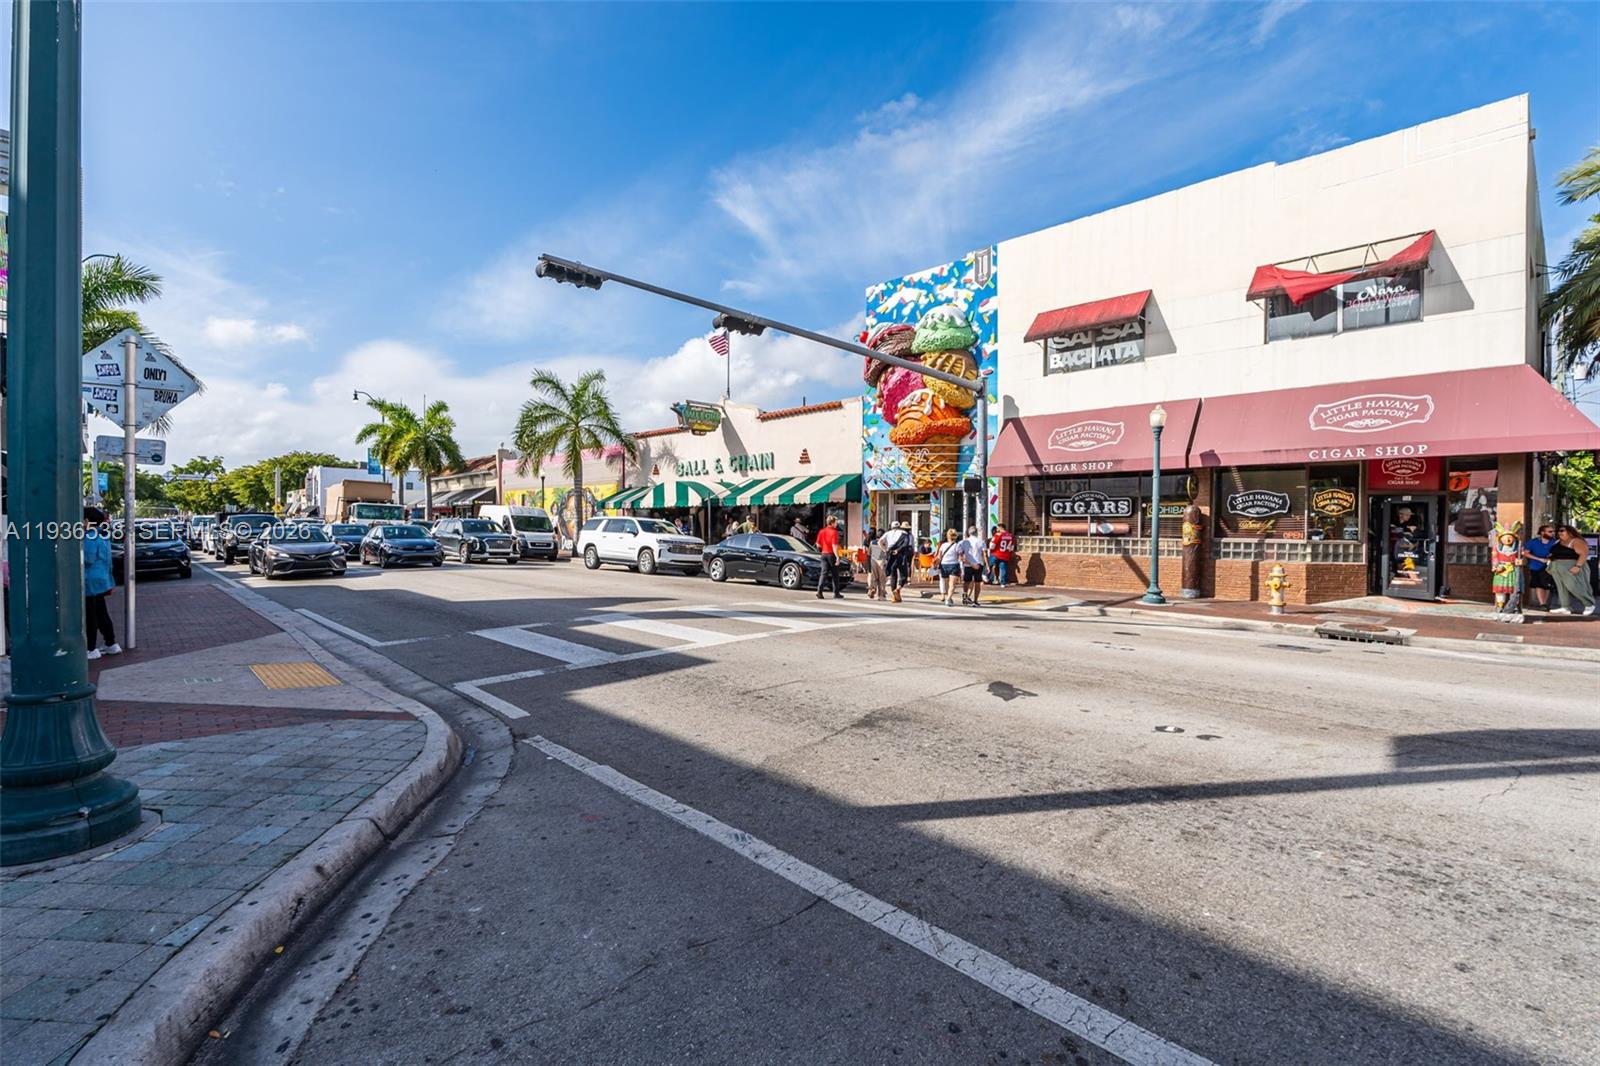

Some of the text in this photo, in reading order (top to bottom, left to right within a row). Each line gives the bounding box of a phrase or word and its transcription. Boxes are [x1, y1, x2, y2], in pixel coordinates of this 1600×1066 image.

[1054, 321, 1143, 349] SALSA
[1050, 342, 1140, 369] BACHATA
[1320, 400, 1420, 418] LITTLE HAVANA
[1326, 409, 1414, 424] CIGAR FACTORY
[1055, 425, 1116, 440] LITTLE HAVANA
[1058, 432, 1111, 444] CIGAR FACTORY
[1308, 444, 1428, 460] CIGAR SHOP
[675, 451, 775, 477] BALL & CHAIN
[1042, 462, 1113, 473] CIGAR SHOP
[1232, 493, 1282, 505] LITTLE HAVANA
[1236, 500, 1280, 510] CIGAR FACTORY
[1052, 500, 1129, 514] CIGARS
[1283, 531, 1304, 540] OPEN
[1000, 540, 1014, 552] 94
